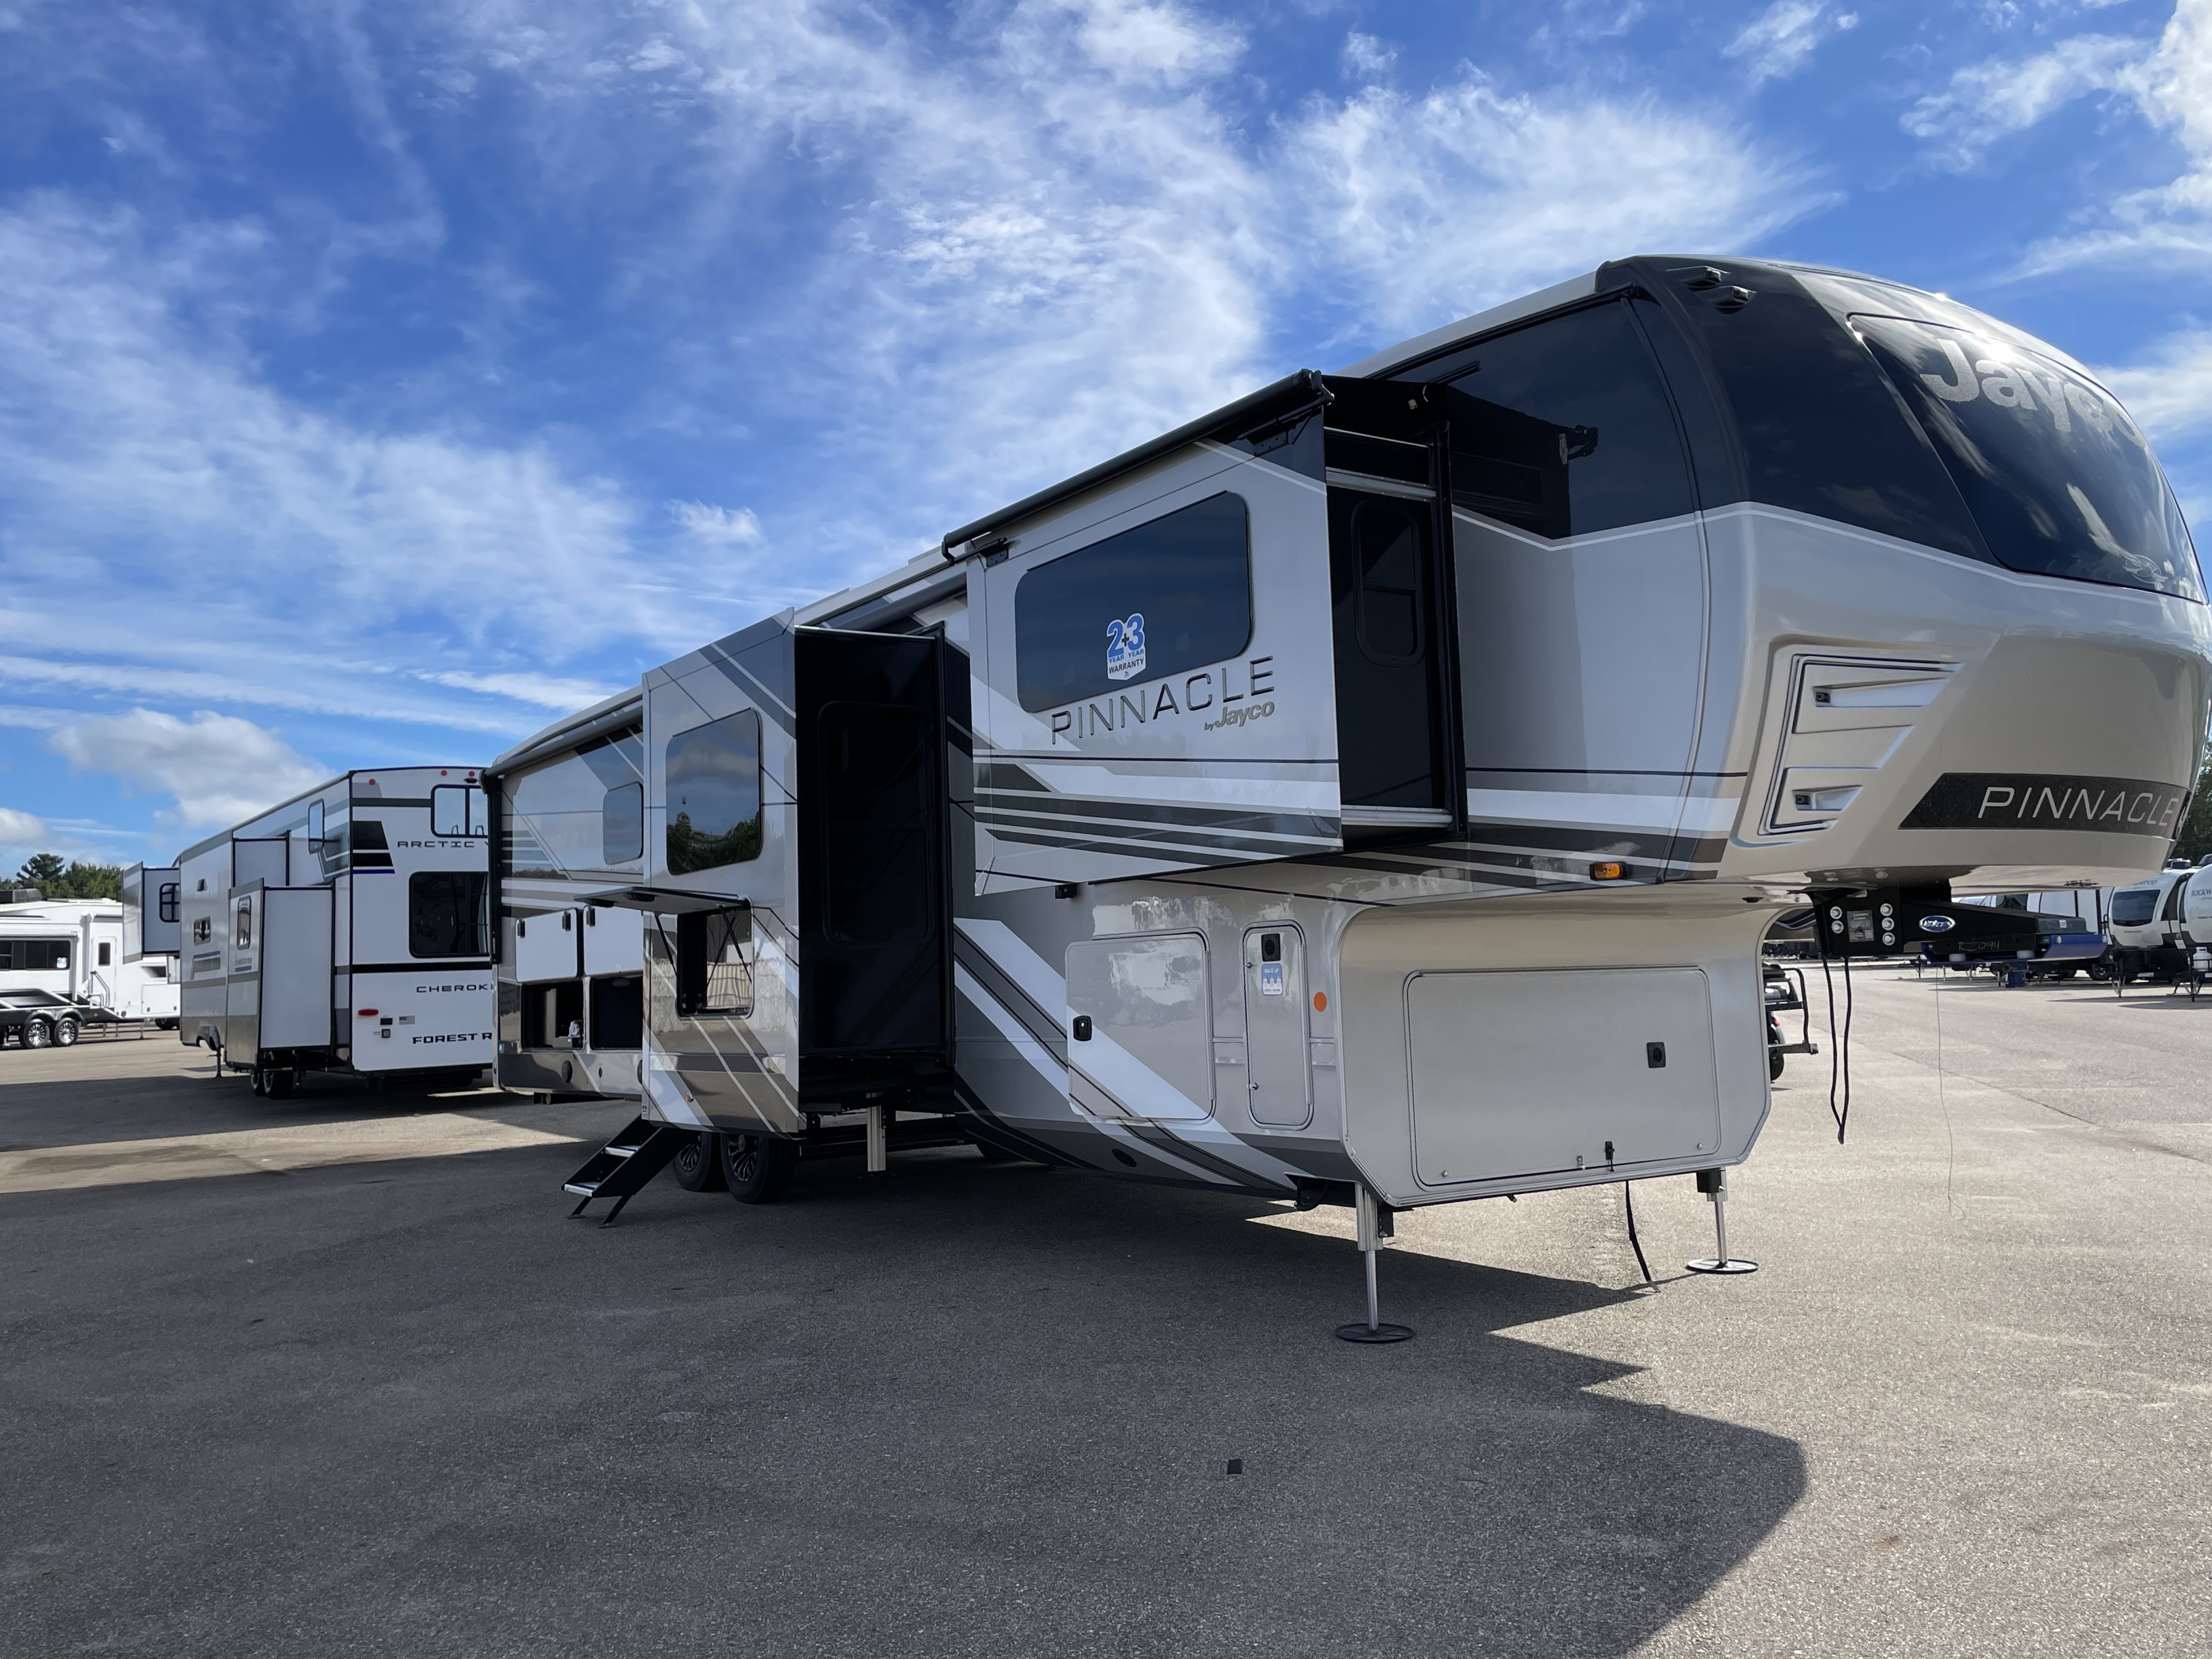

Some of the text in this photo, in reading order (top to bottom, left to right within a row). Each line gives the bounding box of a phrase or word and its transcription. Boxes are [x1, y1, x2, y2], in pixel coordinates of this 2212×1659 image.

[1920, 338, 2147, 448] Jayco
[1108, 648, 1144, 664] YEAR YEAR
[1108, 657, 1145, 674] WARRANTY
[1051, 655, 1275, 745] PINNACLE
[1204, 701, 1275, 732] by Jayco
[1977, 786, 2180, 827] PINNACLE
[416, 983, 493, 993] CHEROK
[412, 1033, 478, 1044] FOREST
